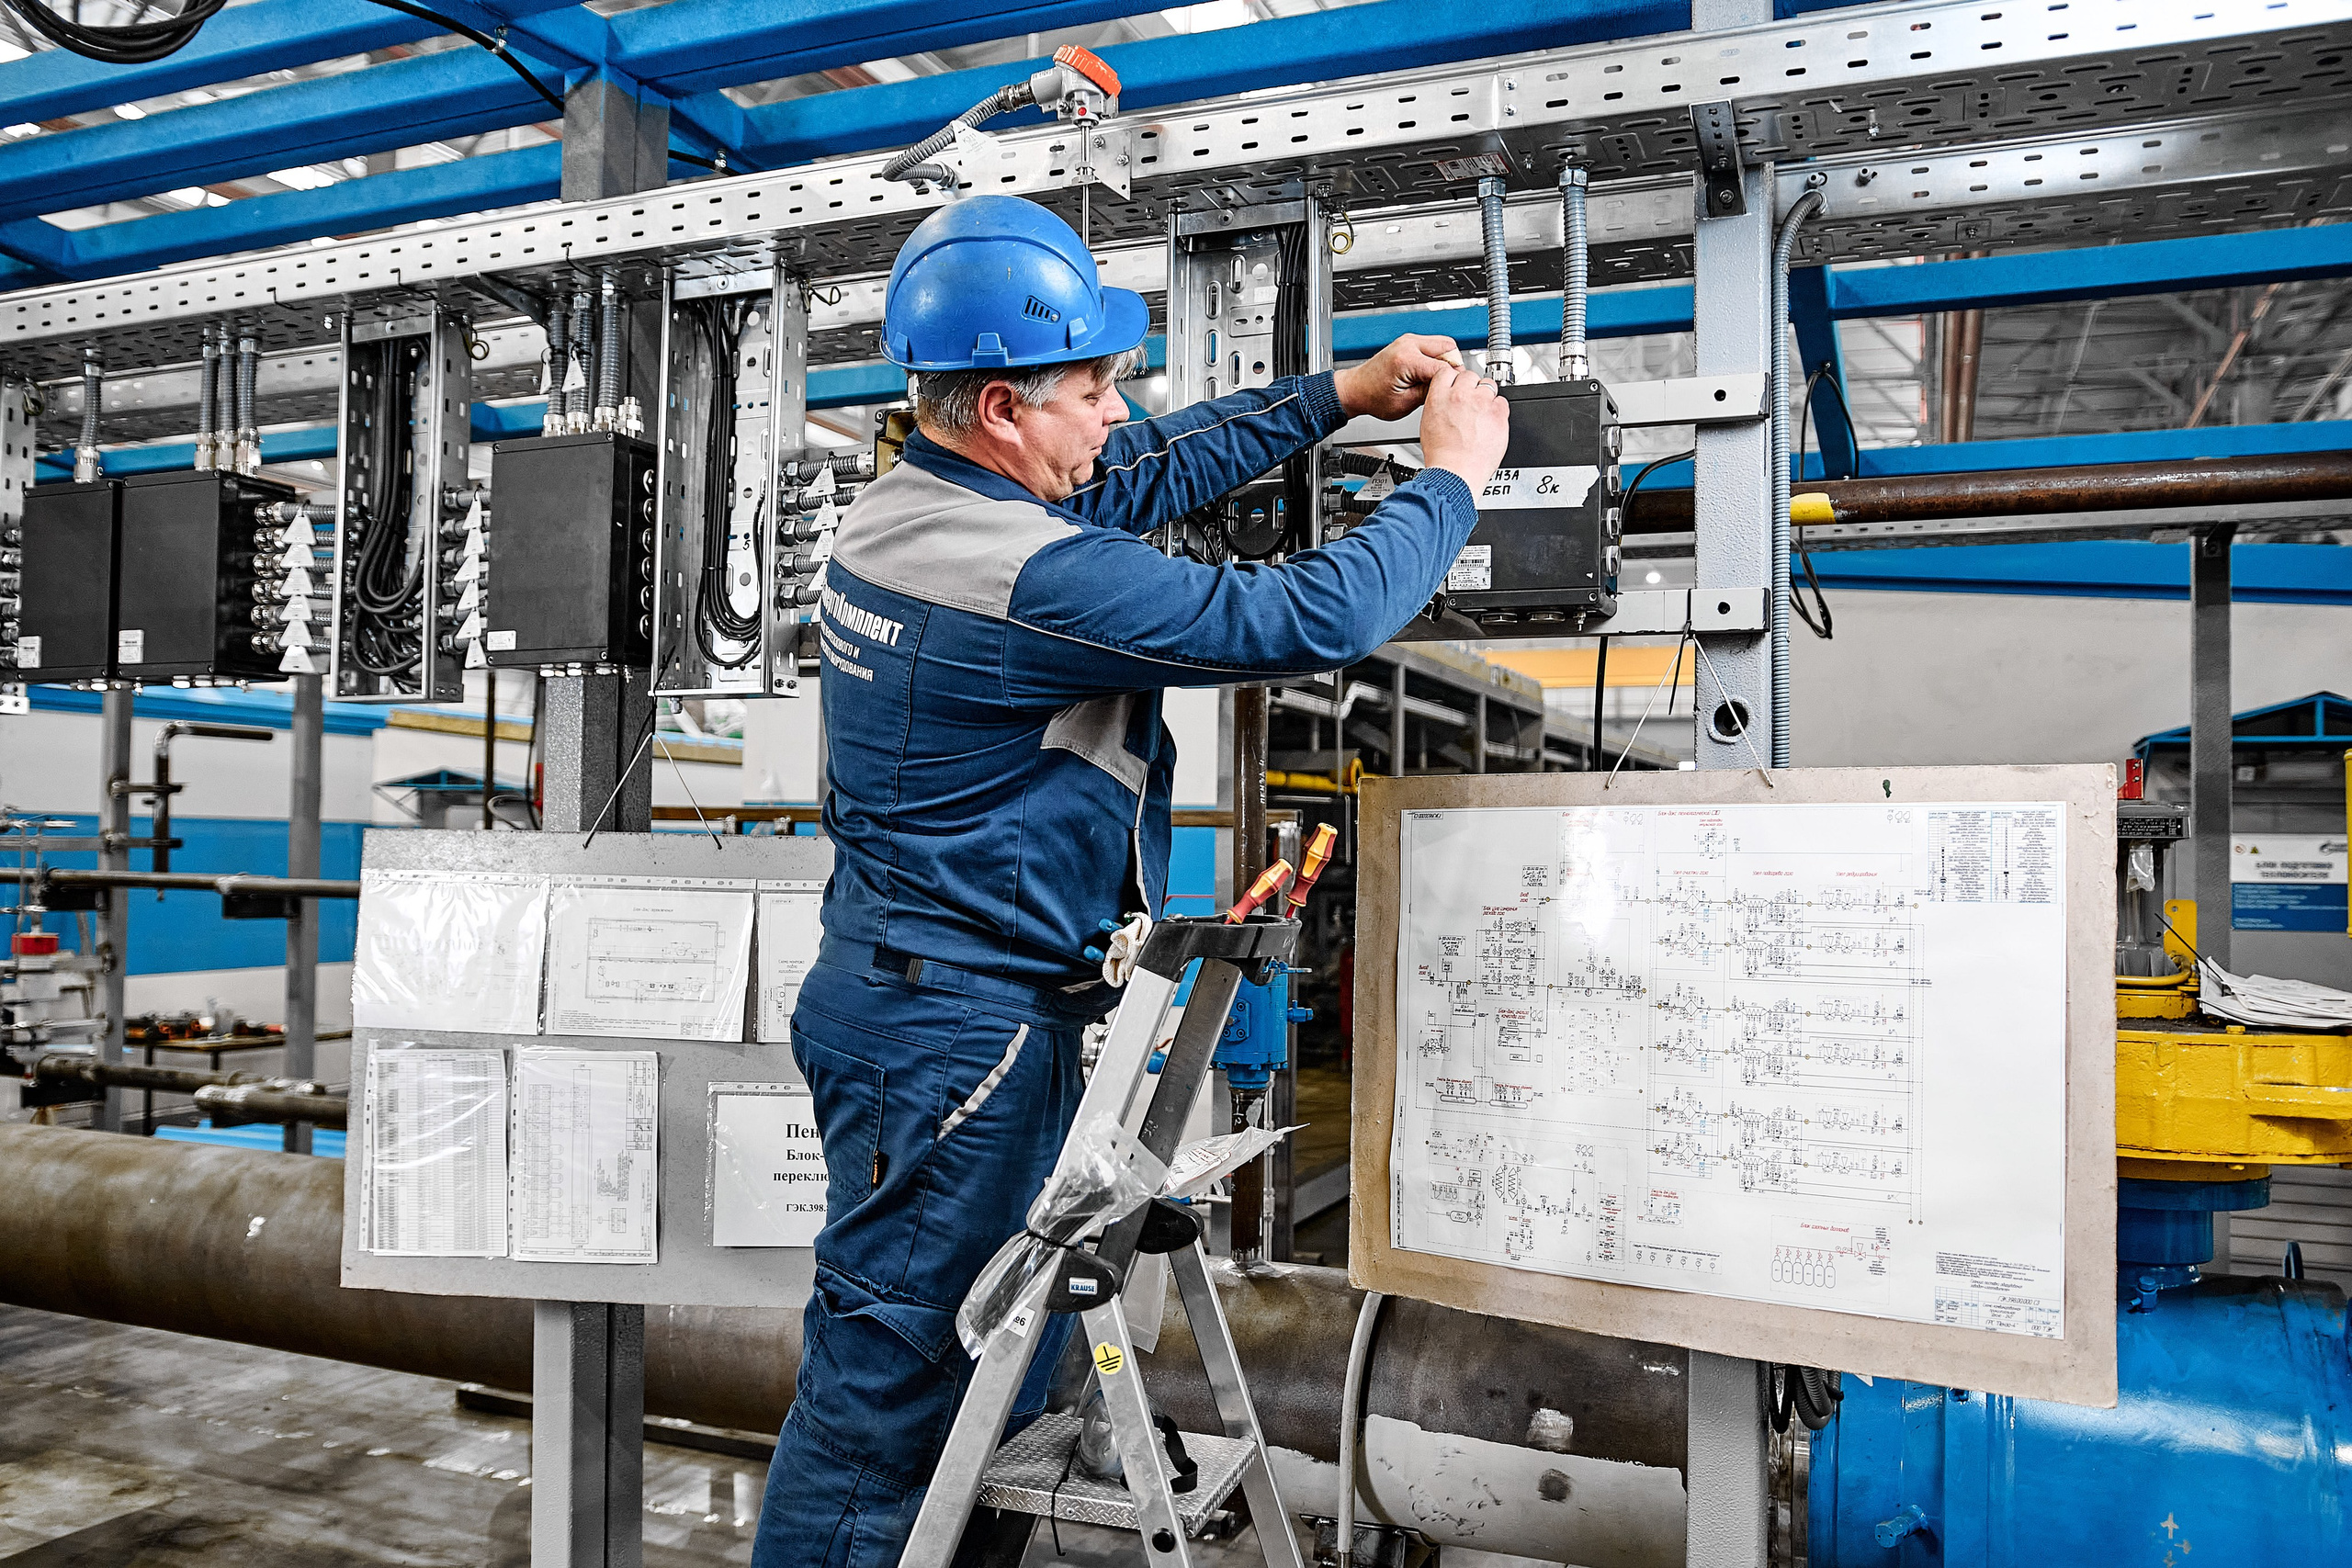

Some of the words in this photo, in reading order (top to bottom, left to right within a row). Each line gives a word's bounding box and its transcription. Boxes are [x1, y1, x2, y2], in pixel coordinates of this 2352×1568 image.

[1489, 469, 1520, 481] НЗА
[786, 1123, 821, 1139] Пен
[786, 1149, 826, 1161] Блок-
[773, 1172, 831, 1185] переклю
[786, 1203, 829, 1213] ГЭК.398.
[1070, 1284, 1095, 1292] KRAUSE
